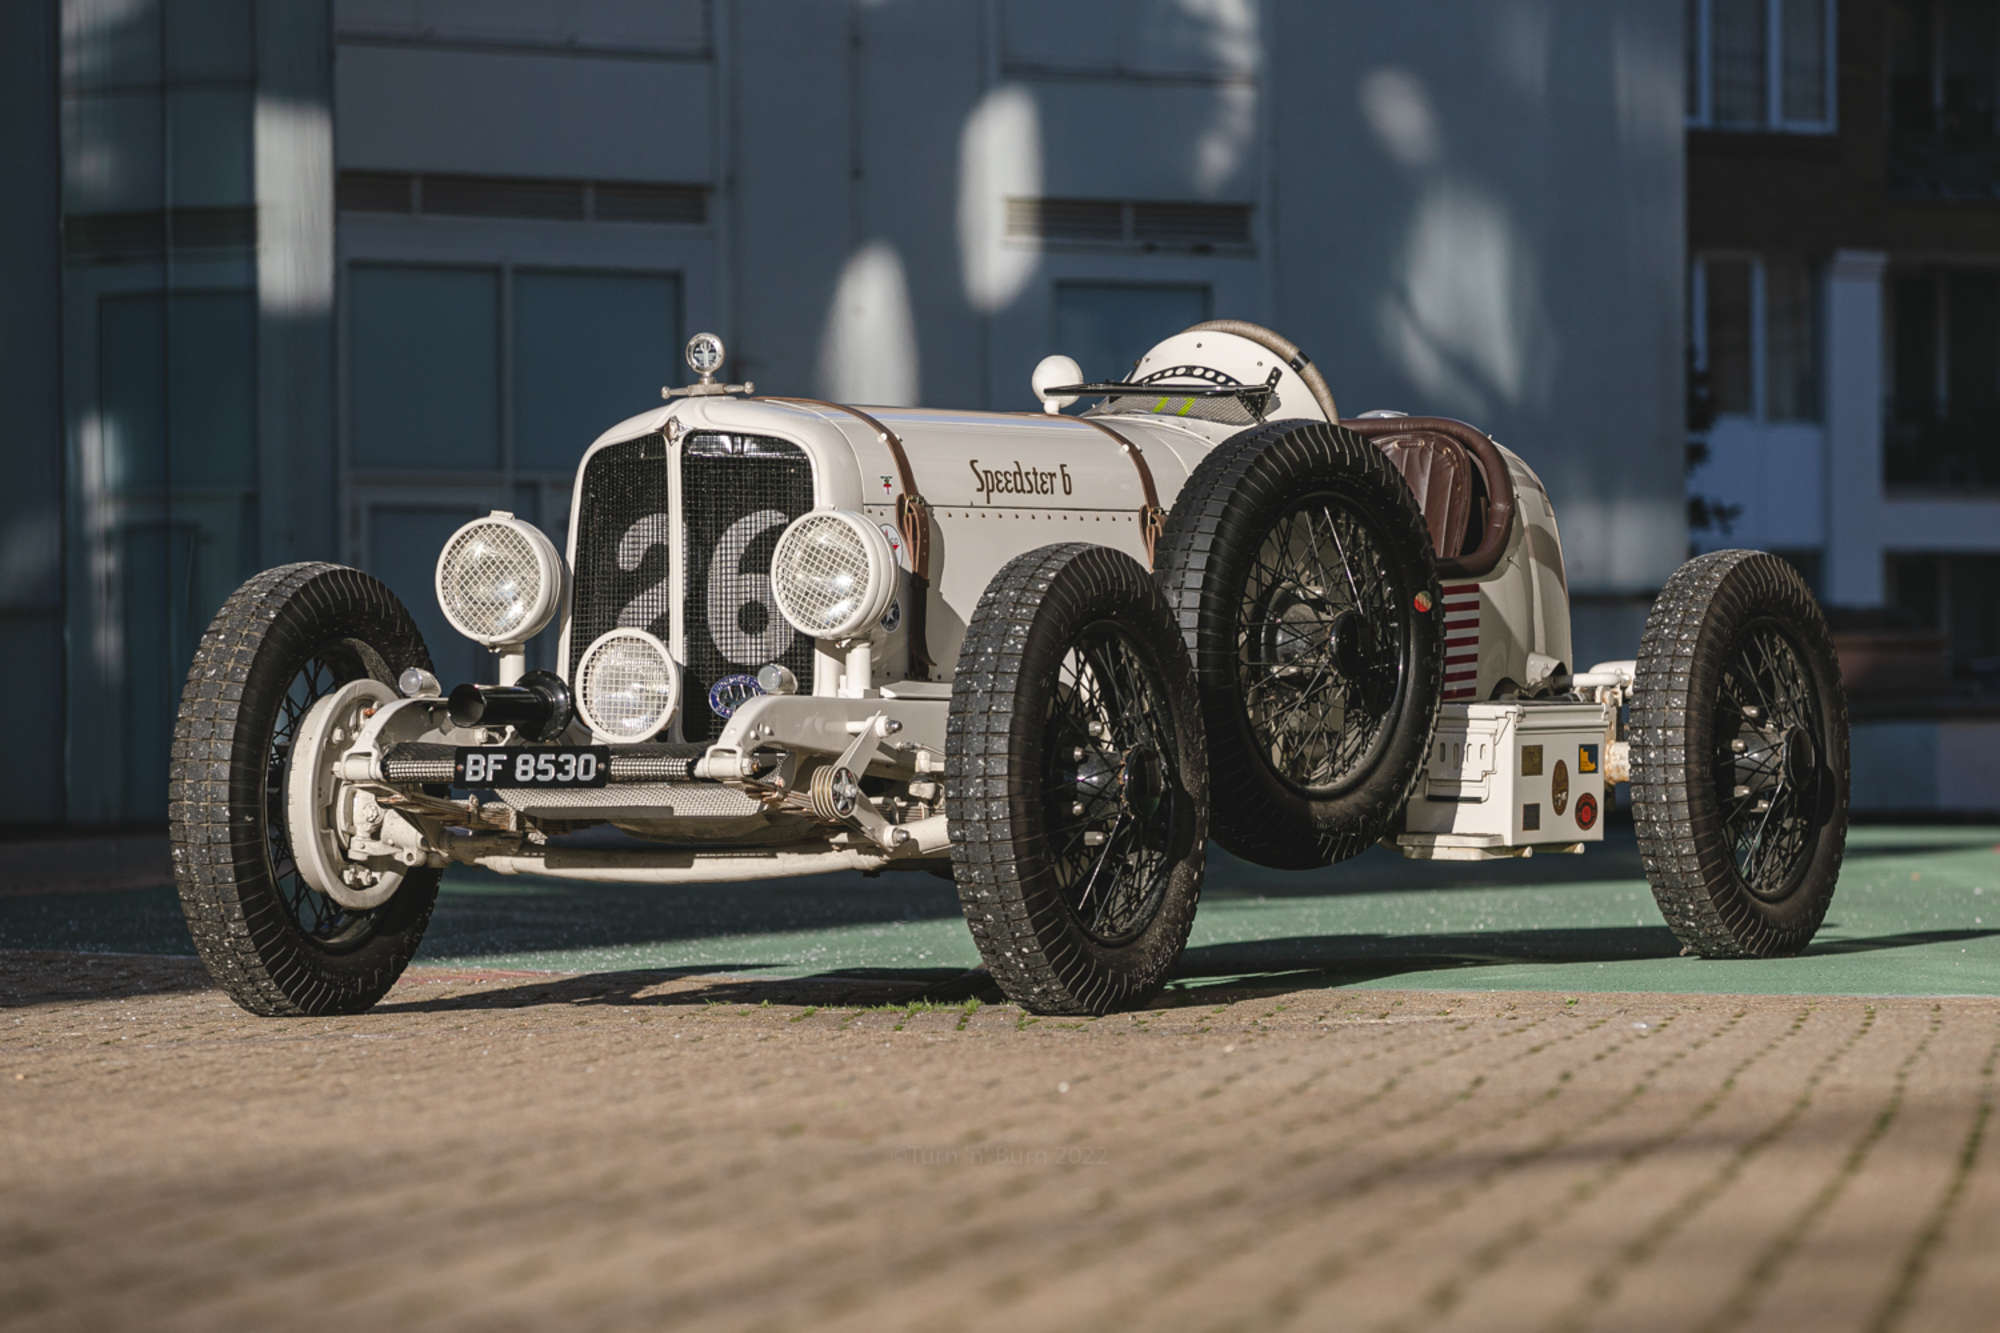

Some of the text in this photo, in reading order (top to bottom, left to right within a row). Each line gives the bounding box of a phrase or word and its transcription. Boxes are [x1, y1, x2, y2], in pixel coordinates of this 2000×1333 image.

[968, 459, 1073, 504] Speedster 6
[617, 509, 795, 667] 26
[465, 753, 597, 782] BF 8530
